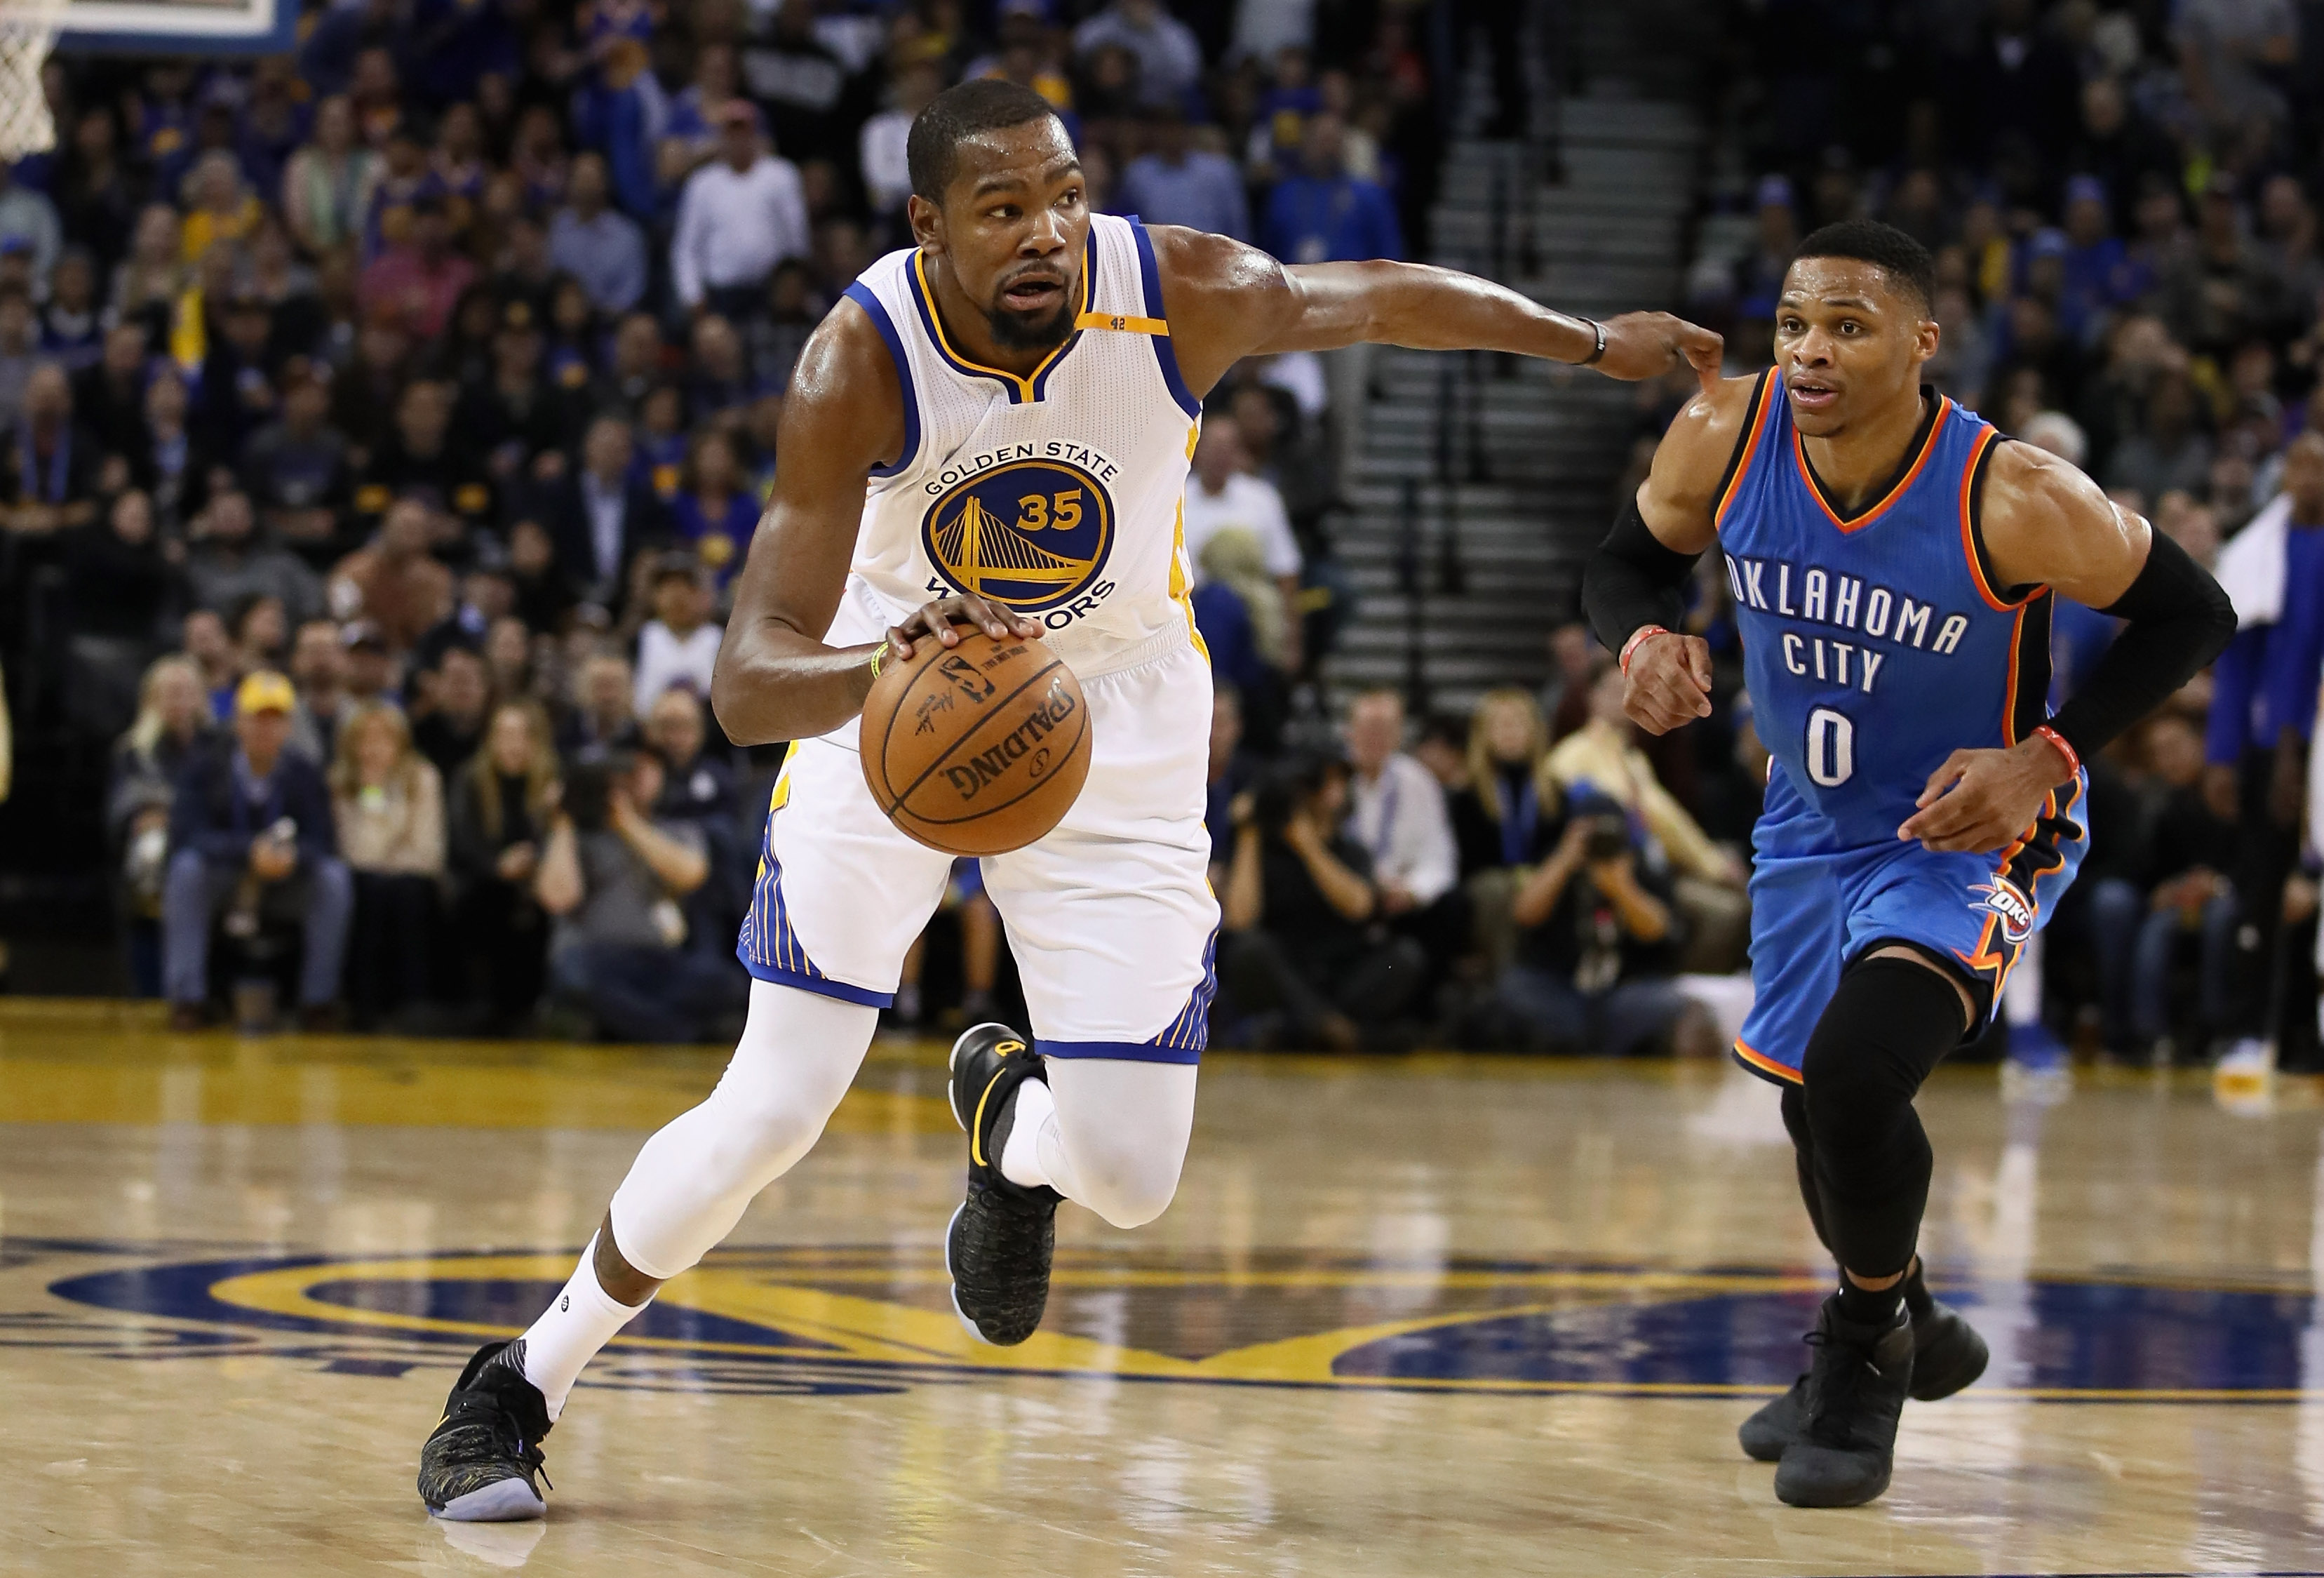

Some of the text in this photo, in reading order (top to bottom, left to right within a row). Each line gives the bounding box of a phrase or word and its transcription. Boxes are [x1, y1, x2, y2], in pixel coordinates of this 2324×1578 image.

[1110, 317, 1125, 330] 42
[925, 442, 1119, 496] GOLDEN STATE
[1016, 488, 1082, 531] 35
[925, 576, 1116, 630] WORS
[1724, 554, 1967, 654] OKLAHOMA
[1784, 634, 1883, 693] CITY
[944, 676, 1075, 801] SPALDING
[1807, 708, 1855, 787] 0
